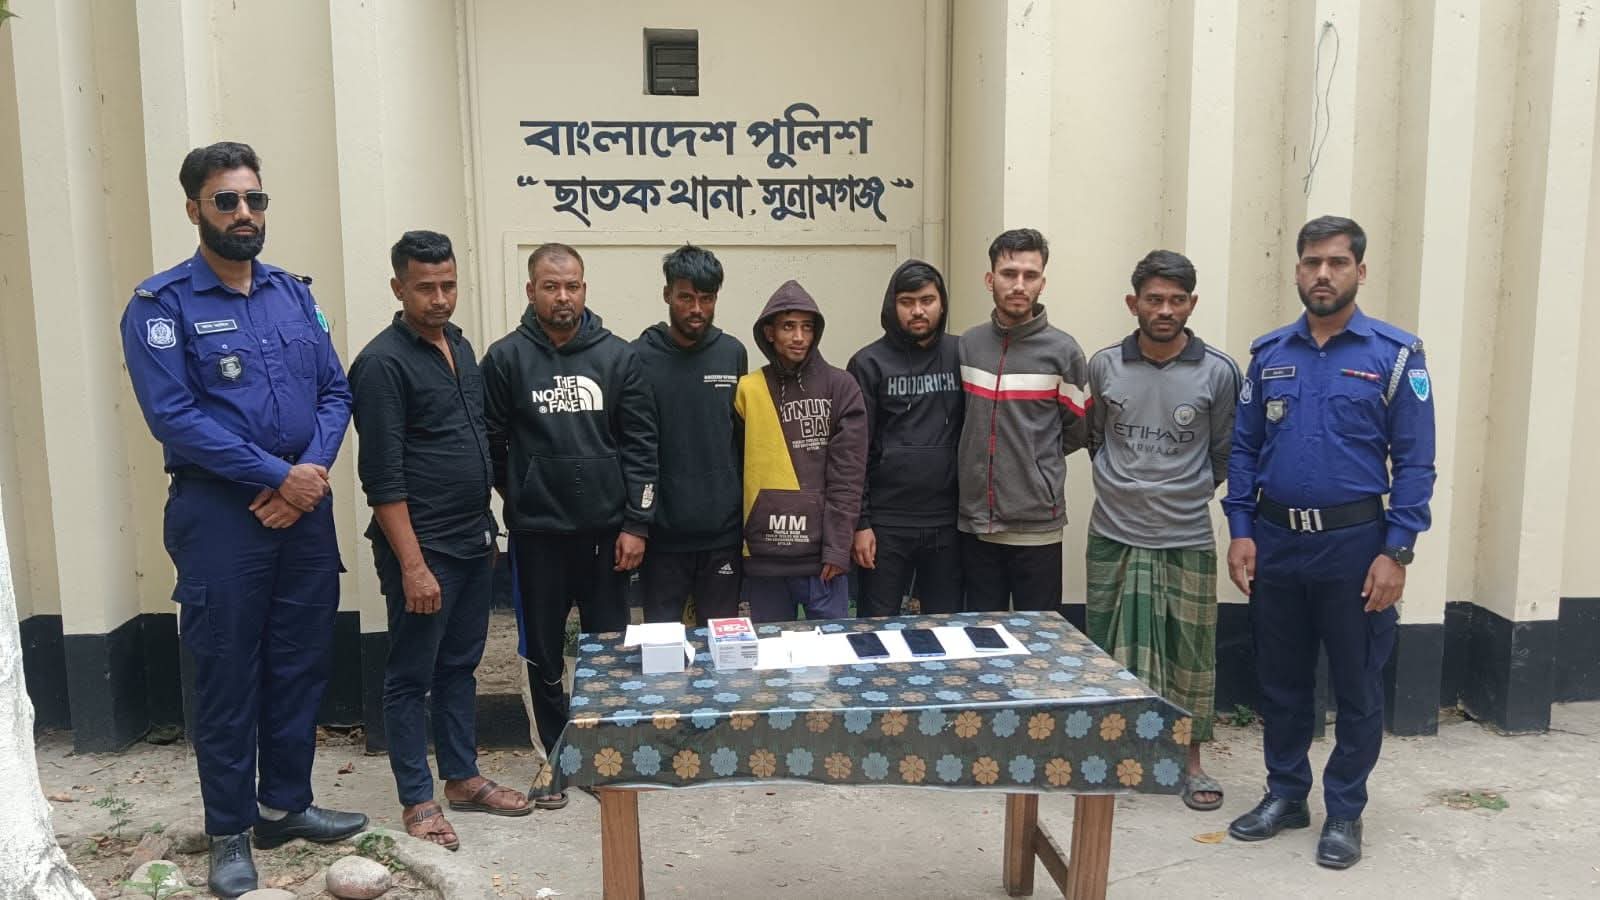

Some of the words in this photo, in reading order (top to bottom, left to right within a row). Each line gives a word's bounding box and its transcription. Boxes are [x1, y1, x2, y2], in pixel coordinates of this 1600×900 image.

[519, 120, 736, 158] বাংলাদেশ
[746, 102, 873, 169] পুলিশ
[553, 375, 577, 389] THE
[531, 386, 579, 403] NORTH
[549, 400, 580, 413] FACE
[1113, 422, 1195, 444] ETIHAD
